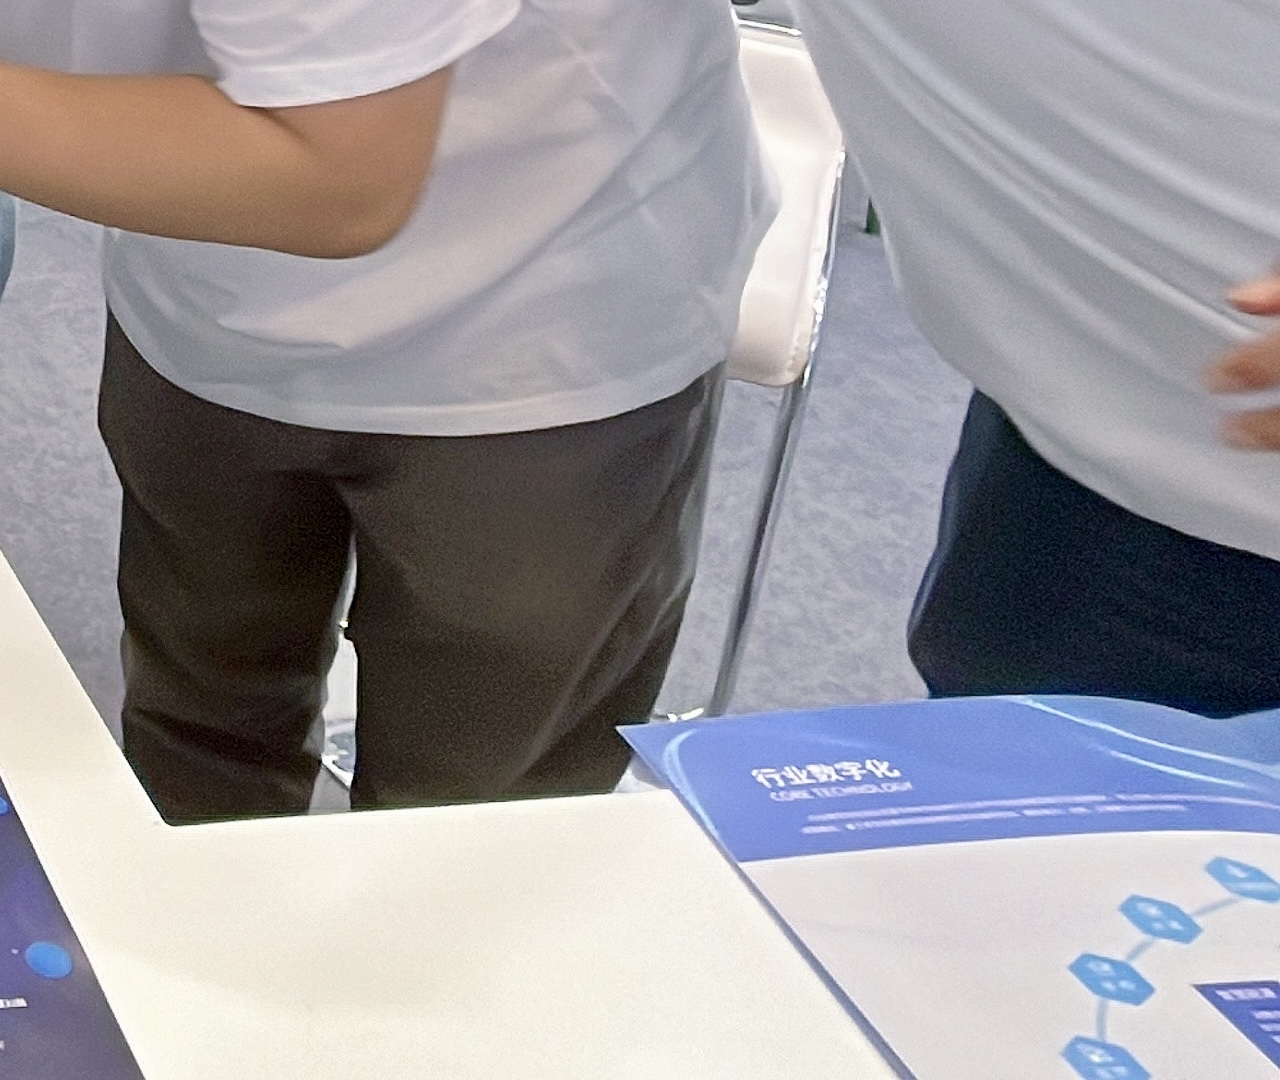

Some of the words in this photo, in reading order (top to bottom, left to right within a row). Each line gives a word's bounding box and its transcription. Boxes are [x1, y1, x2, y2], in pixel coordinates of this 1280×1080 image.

[751, 758, 903, 789] 行业数字化
